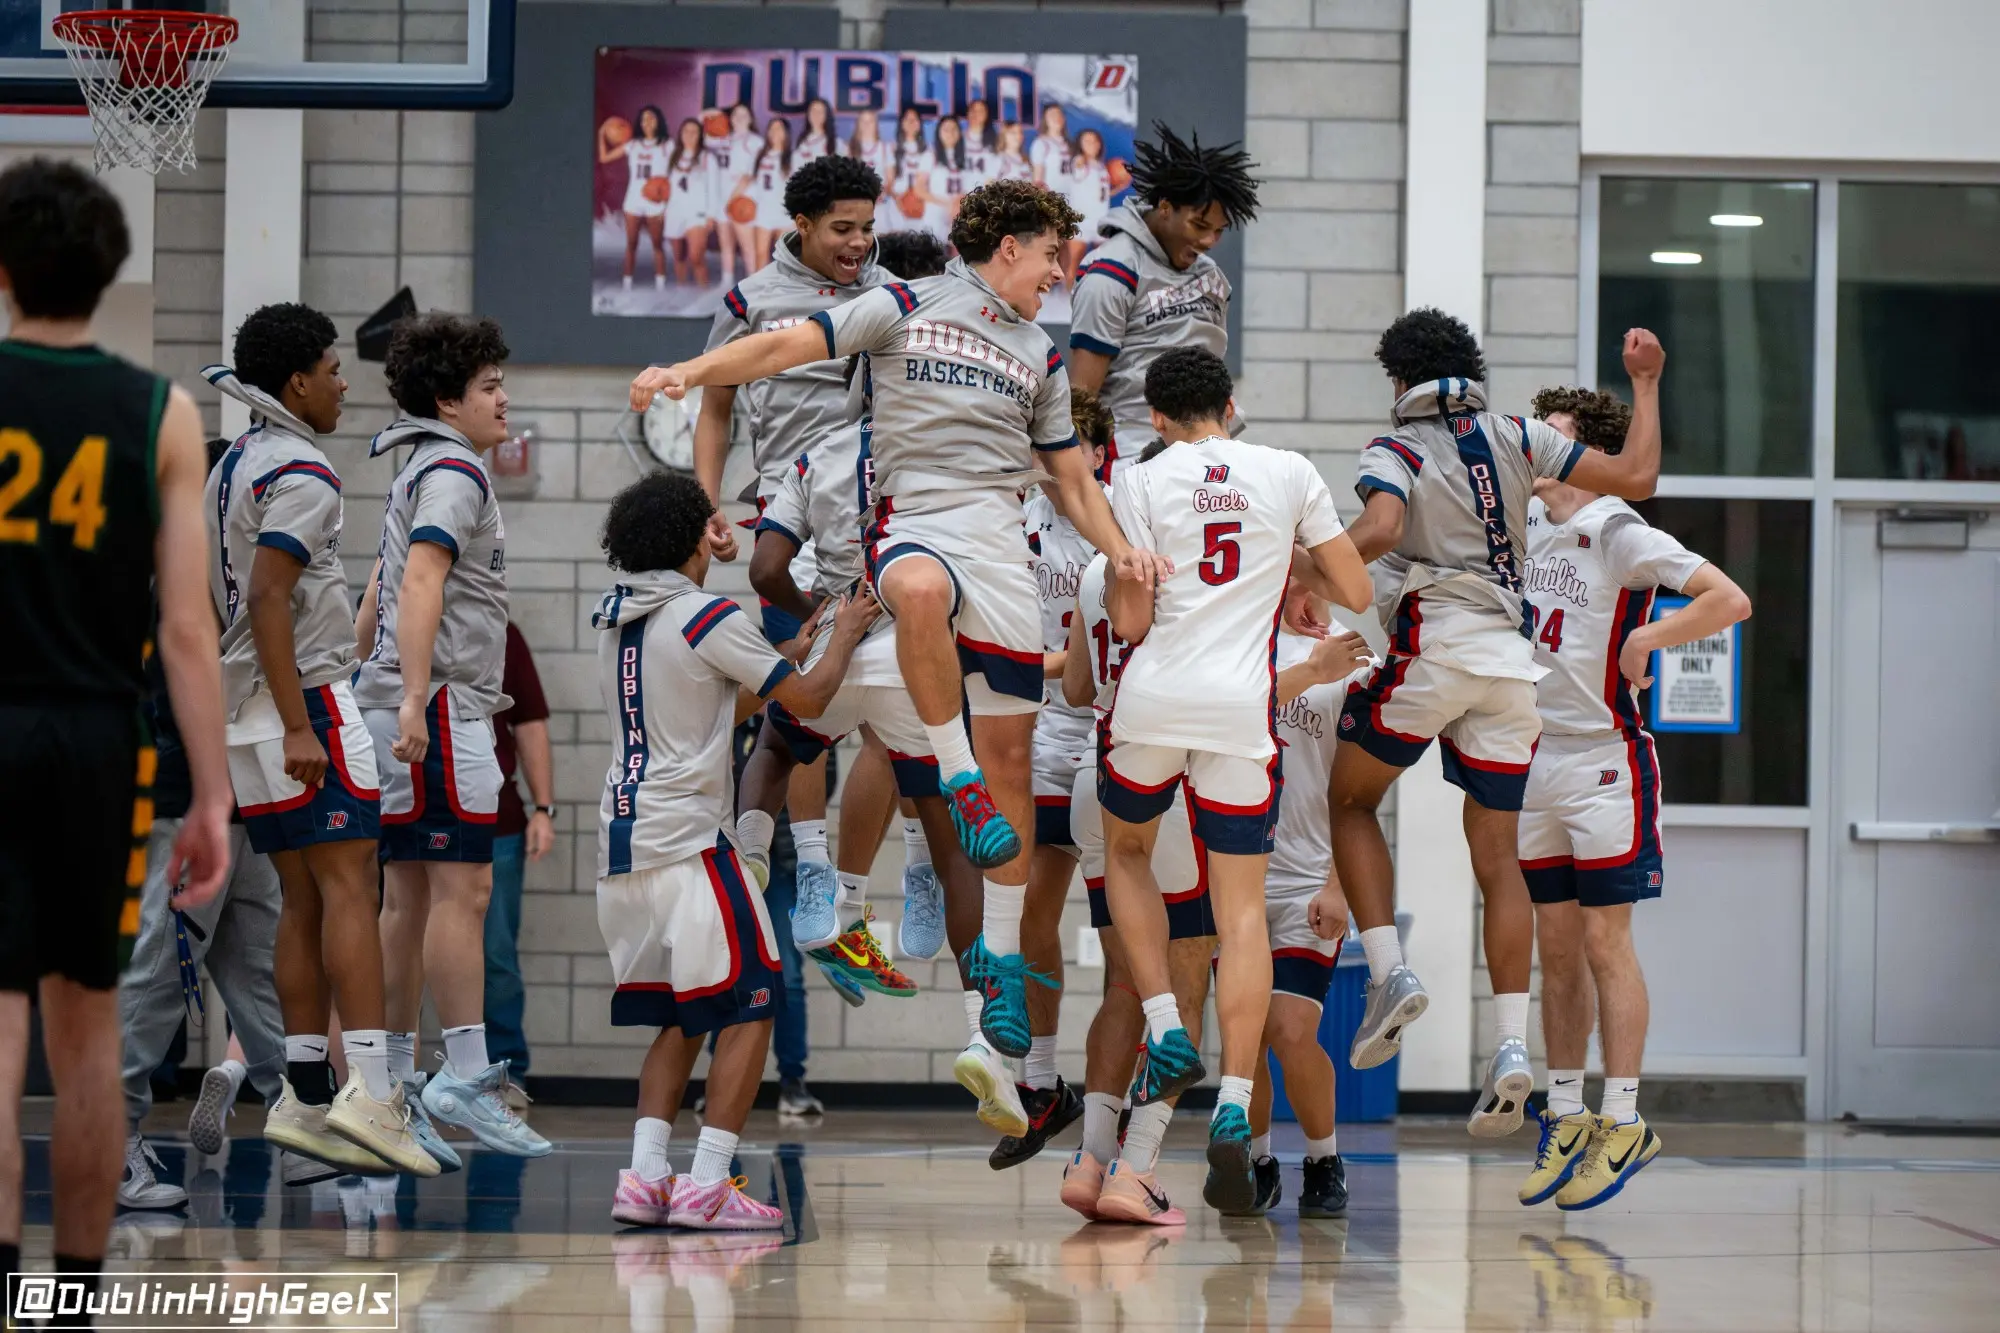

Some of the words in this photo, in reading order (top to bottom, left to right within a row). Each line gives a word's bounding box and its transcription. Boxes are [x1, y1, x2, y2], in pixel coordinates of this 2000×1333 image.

[702, 55, 1038, 127] DUBLIN
[0, 426, 107, 550] 24
[1203, 465, 1230, 483] D
[1193, 488, 1249, 513] Gaels
[1199, 521, 1242, 586] 5
[1036, 561, 1088, 602] Dub
[1522, 556, 1589, 607] Dublin
[1532, 604, 1565, 653] 4
[1681, 657, 1714, 674] ONLY
[622, 646, 643, 746] DUBLIN
